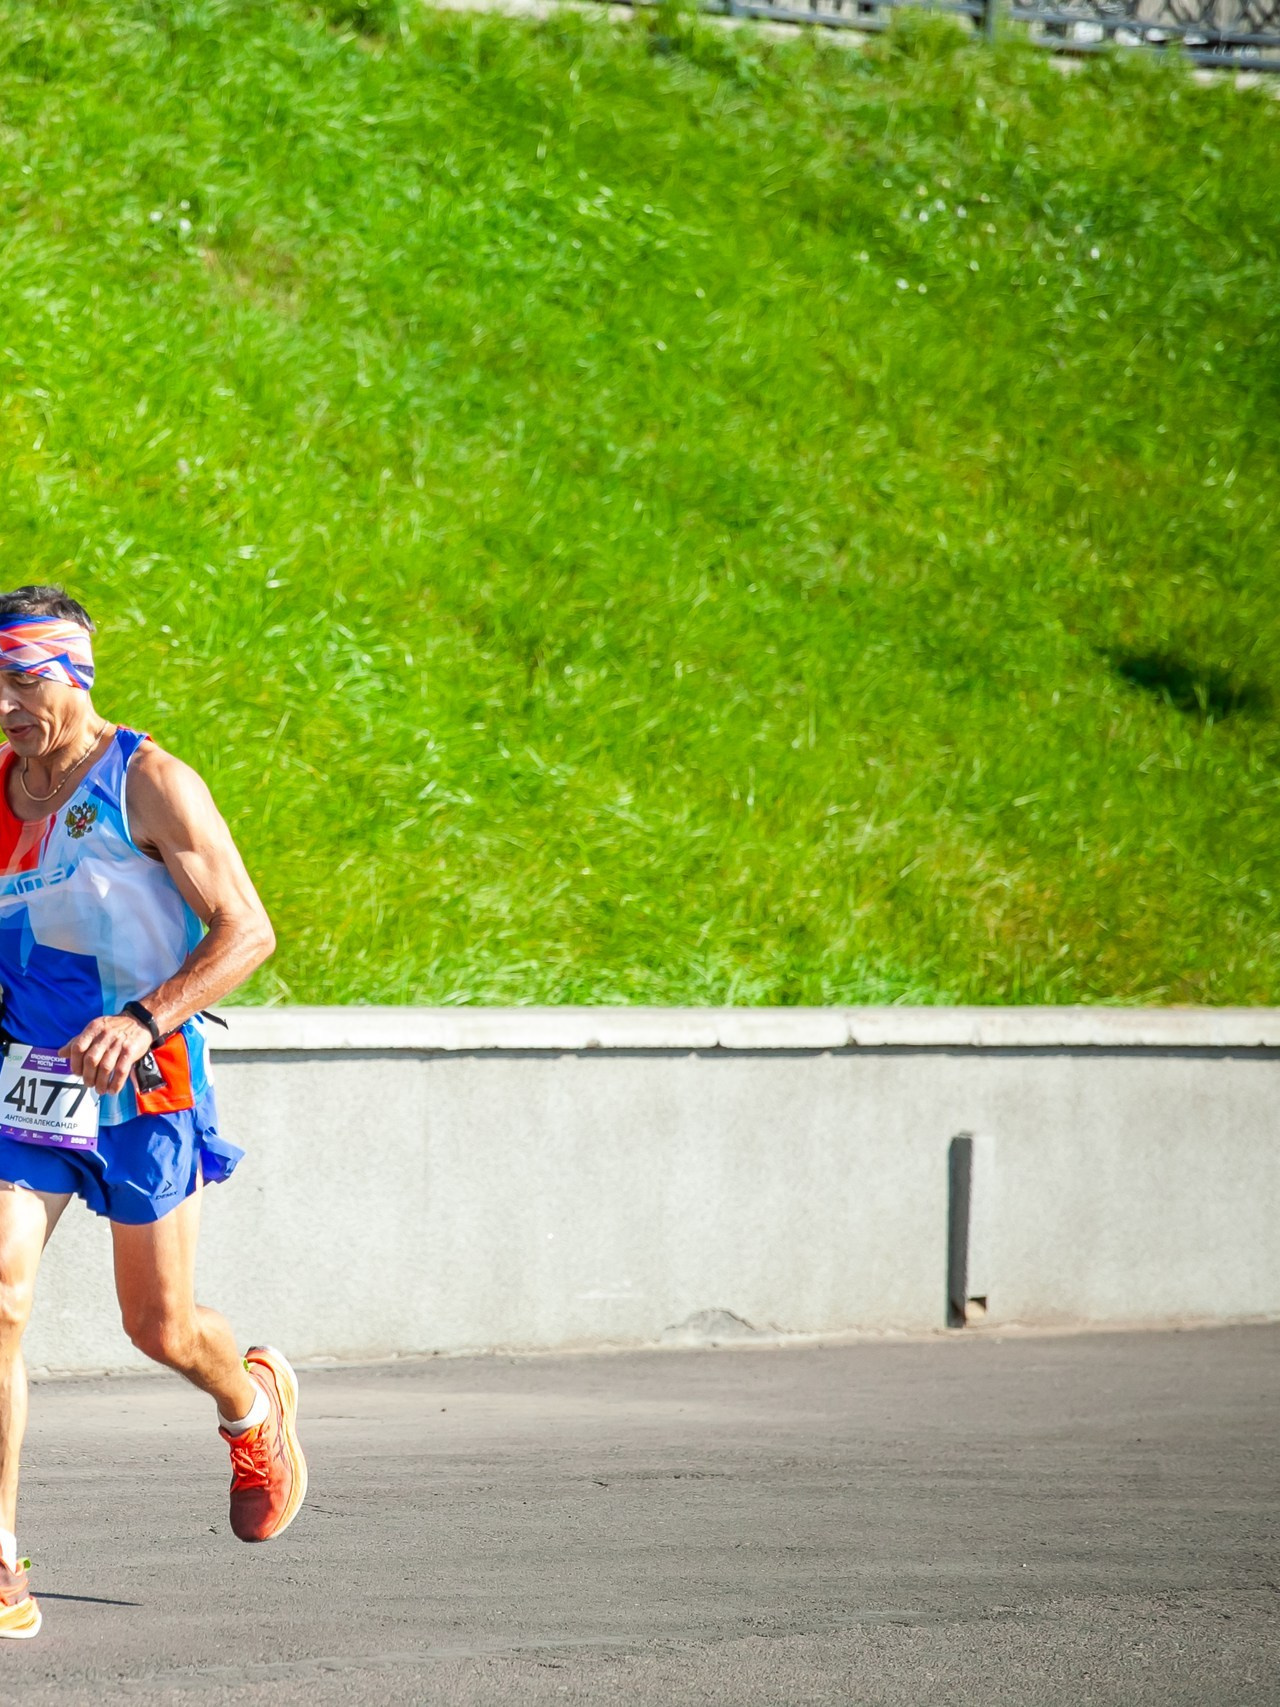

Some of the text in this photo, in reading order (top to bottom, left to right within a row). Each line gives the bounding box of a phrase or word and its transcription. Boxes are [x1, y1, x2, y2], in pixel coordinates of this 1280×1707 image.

[3, 1075, 89, 1119] 4177
[4, 1113, 78, 1129] АНТОНОВ АЛЕКСАНДР
